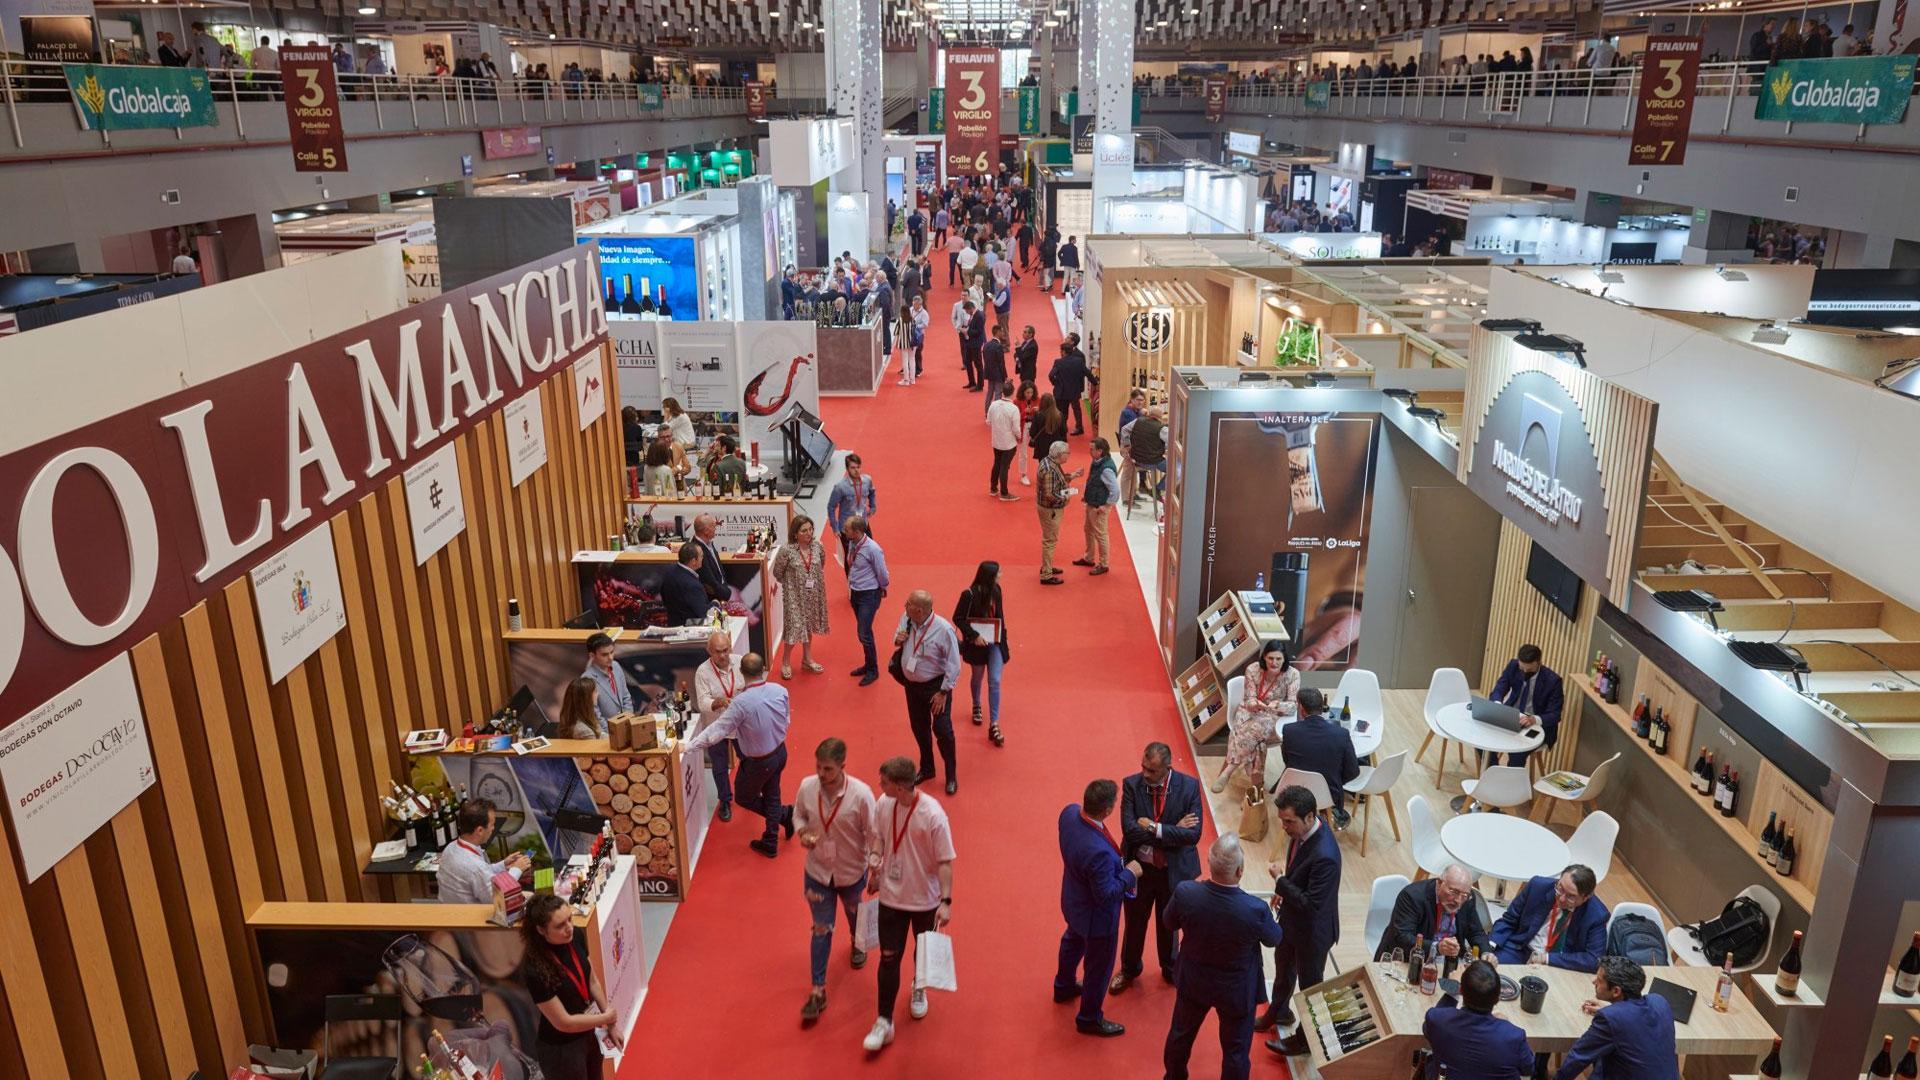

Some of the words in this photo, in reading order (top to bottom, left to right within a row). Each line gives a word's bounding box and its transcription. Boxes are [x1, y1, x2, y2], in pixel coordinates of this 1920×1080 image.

[1650, 42, 1698, 51] FENAVIN
[283, 52, 328, 61] FENAVIN
[949, 54, 995, 63] FENAVIN
[1654, 59, 1682, 99] 3
[296, 69, 325, 107] 3
[959, 71, 985, 110] 3
[1211, 87, 1220, 100] 3
[751, 89, 760, 101] 3
[1791, 79, 1880, 113] Globalcaja
[109, 86, 191, 118] Globalcaja
[1646, 100, 1685, 109] VIRGILIO
[294, 108, 333, 117] VIRGILIO
[953, 111, 992, 120] VIRGILIO
[1634, 145, 1656, 153] Calle
[1660, 141, 1675, 161] 7
[297, 152, 319, 161] Calle
[322, 148, 337, 168] 5
[949, 155, 971, 164] Calle
[975, 151, 989, 172] 6
[599, 246, 622, 254] Nueva
[621, 256, 631, 264] de
[1264, 415, 1330, 424] INALTERABLE
[0, 446, 160, 696] O
[160, 361, 357, 584] LA
[344, 250, 609, 479] MANCHA
[727, 515, 737, 524] LA
[740, 515, 777, 524] MANCHA
[1206, 526, 1217, 562] PLACER
[1338, 540, 1361, 548] LaLiga
[0, 729, 36, 758] BODEGAS
[37, 718, 53, 734] DON
[53, 698, 83, 722] OCTAVIO
[20, 771, 64, 808] BODEGAS
